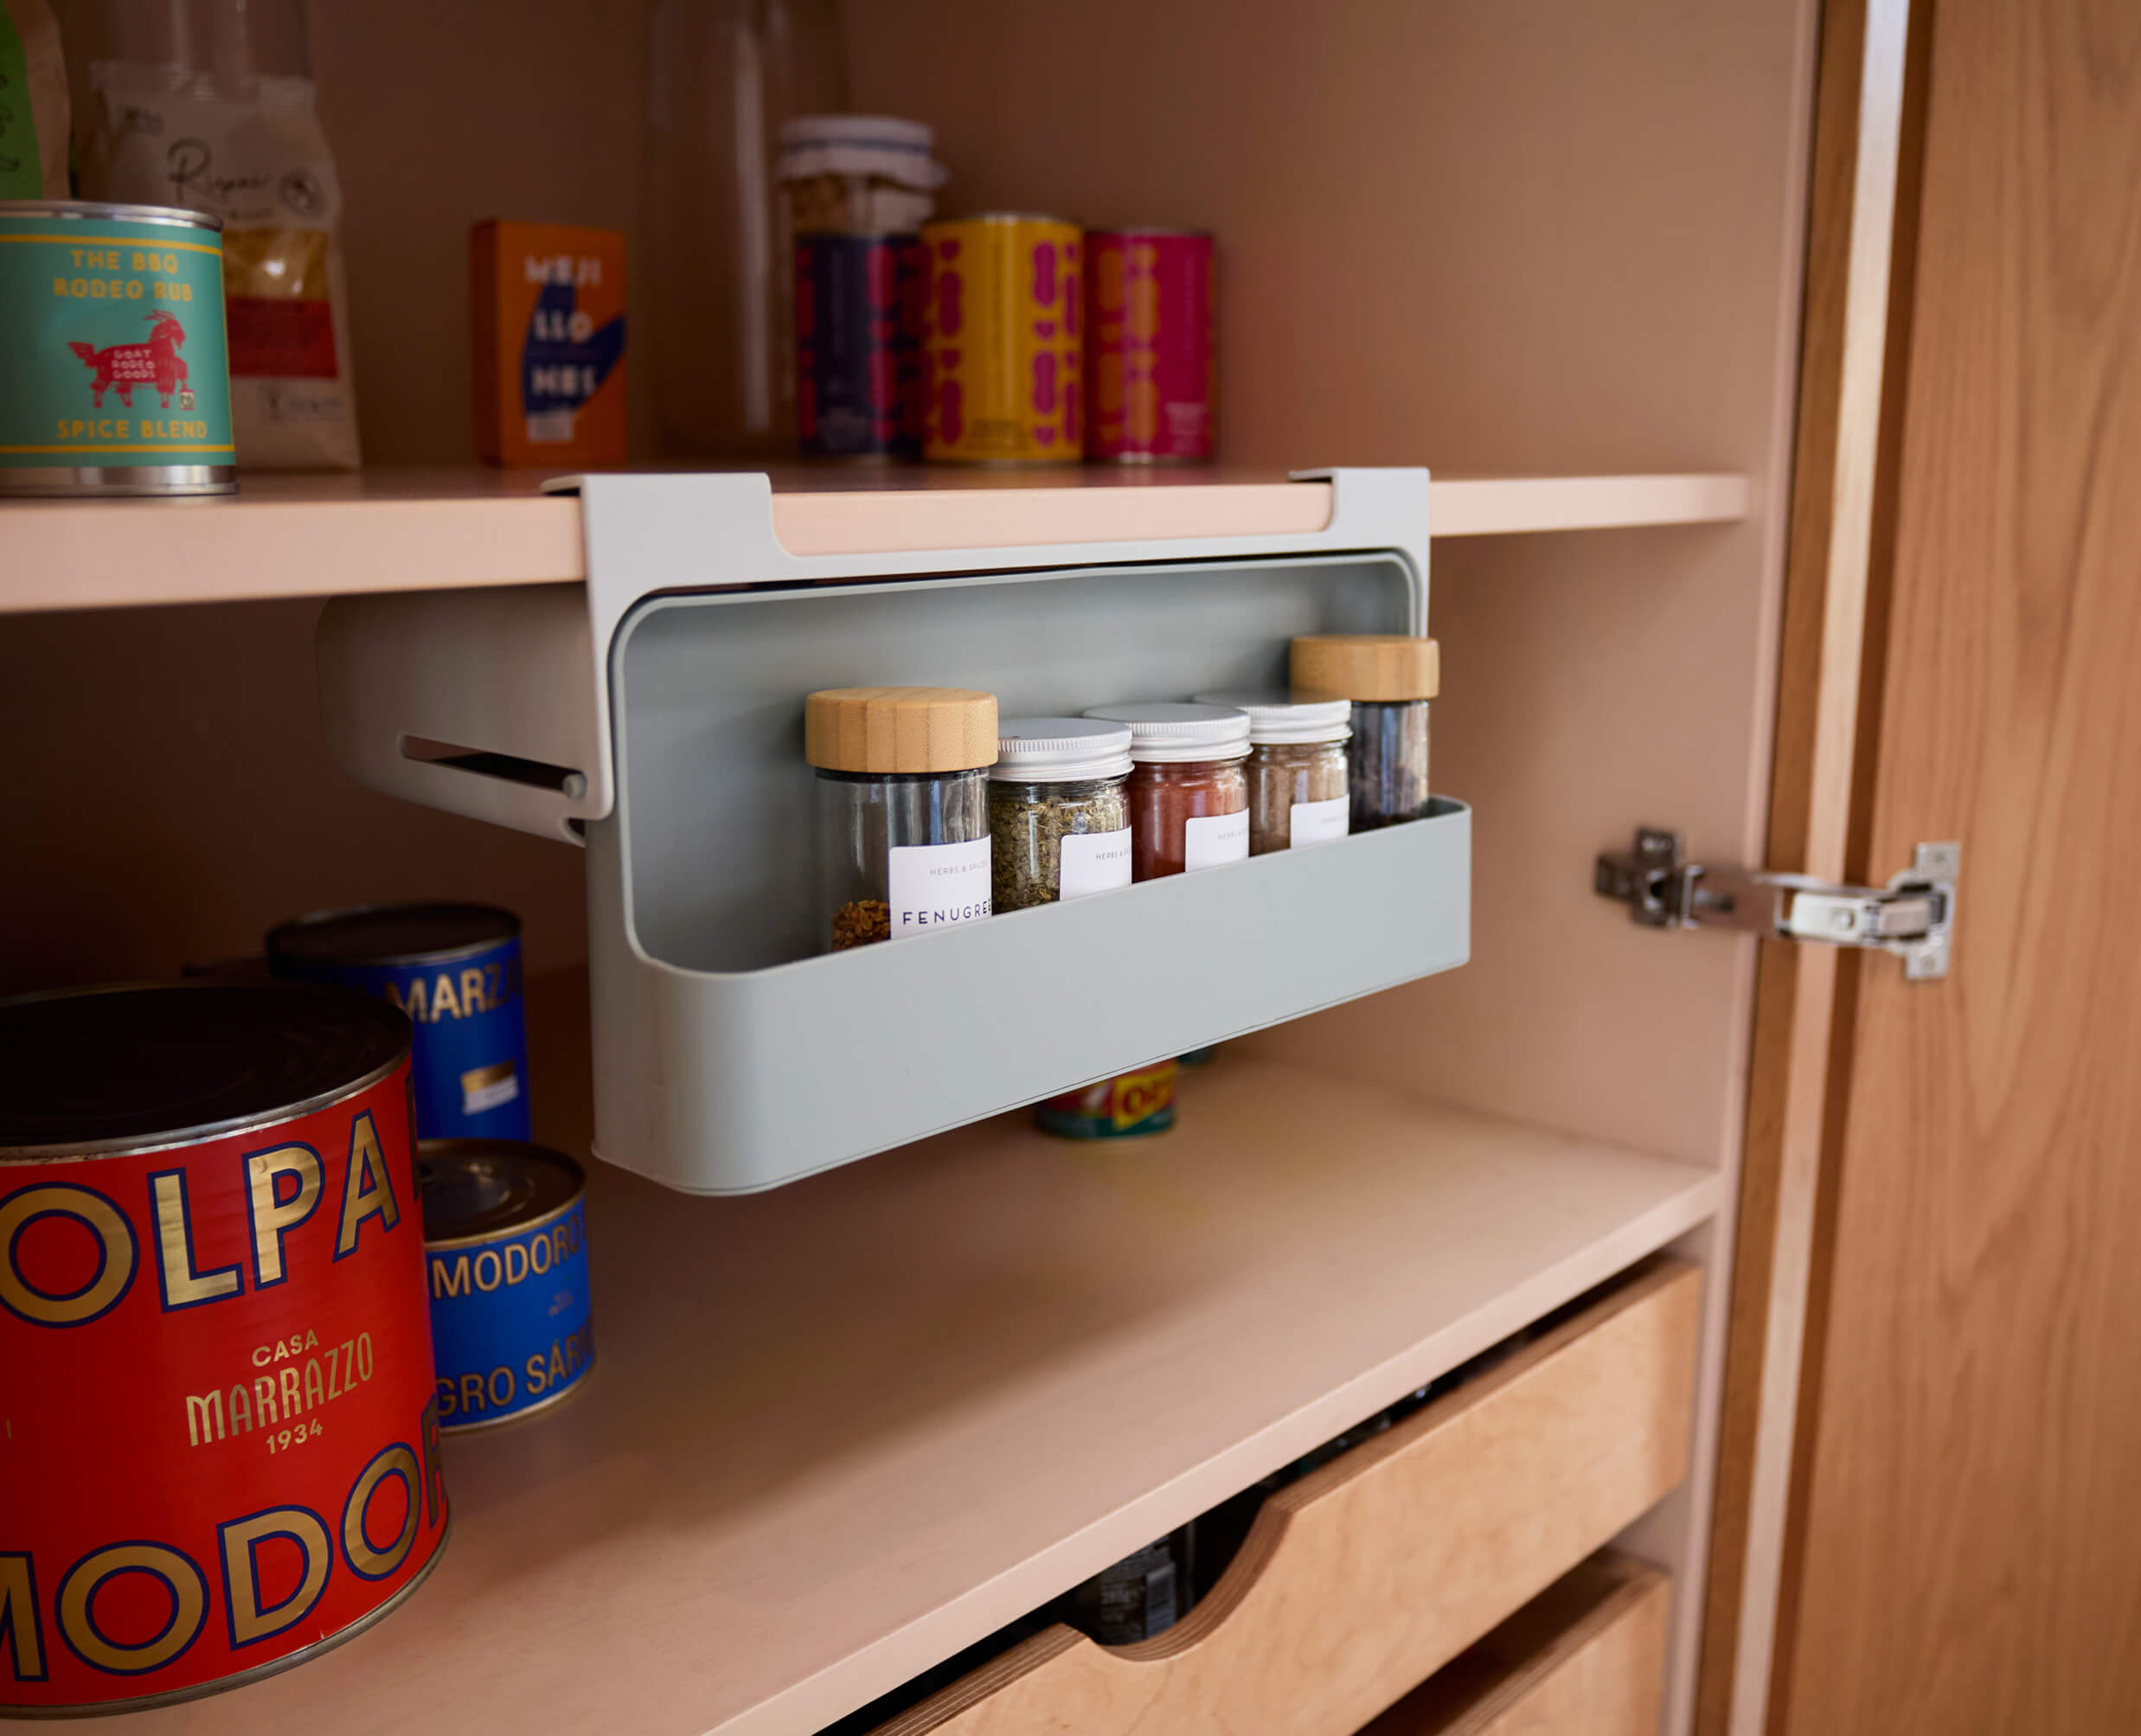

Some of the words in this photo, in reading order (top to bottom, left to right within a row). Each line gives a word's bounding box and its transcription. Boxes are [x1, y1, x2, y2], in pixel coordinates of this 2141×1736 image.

[69, 249, 122, 270] THE
[131, 253, 178, 275] BBQ
[54, 277, 144, 299] RODEO
[153, 282, 193, 302] RUB
[113, 349, 152, 360] GOAT
[56, 419, 130, 439] SPICE
[140, 420, 208, 439] BLEND
[929, 867, 958, 876] HERBS
[252, 1329, 319, 1368] CASA
[186, 1332, 374, 1447] MARRAZZO
[266, 1419, 324, 1455] 1934
